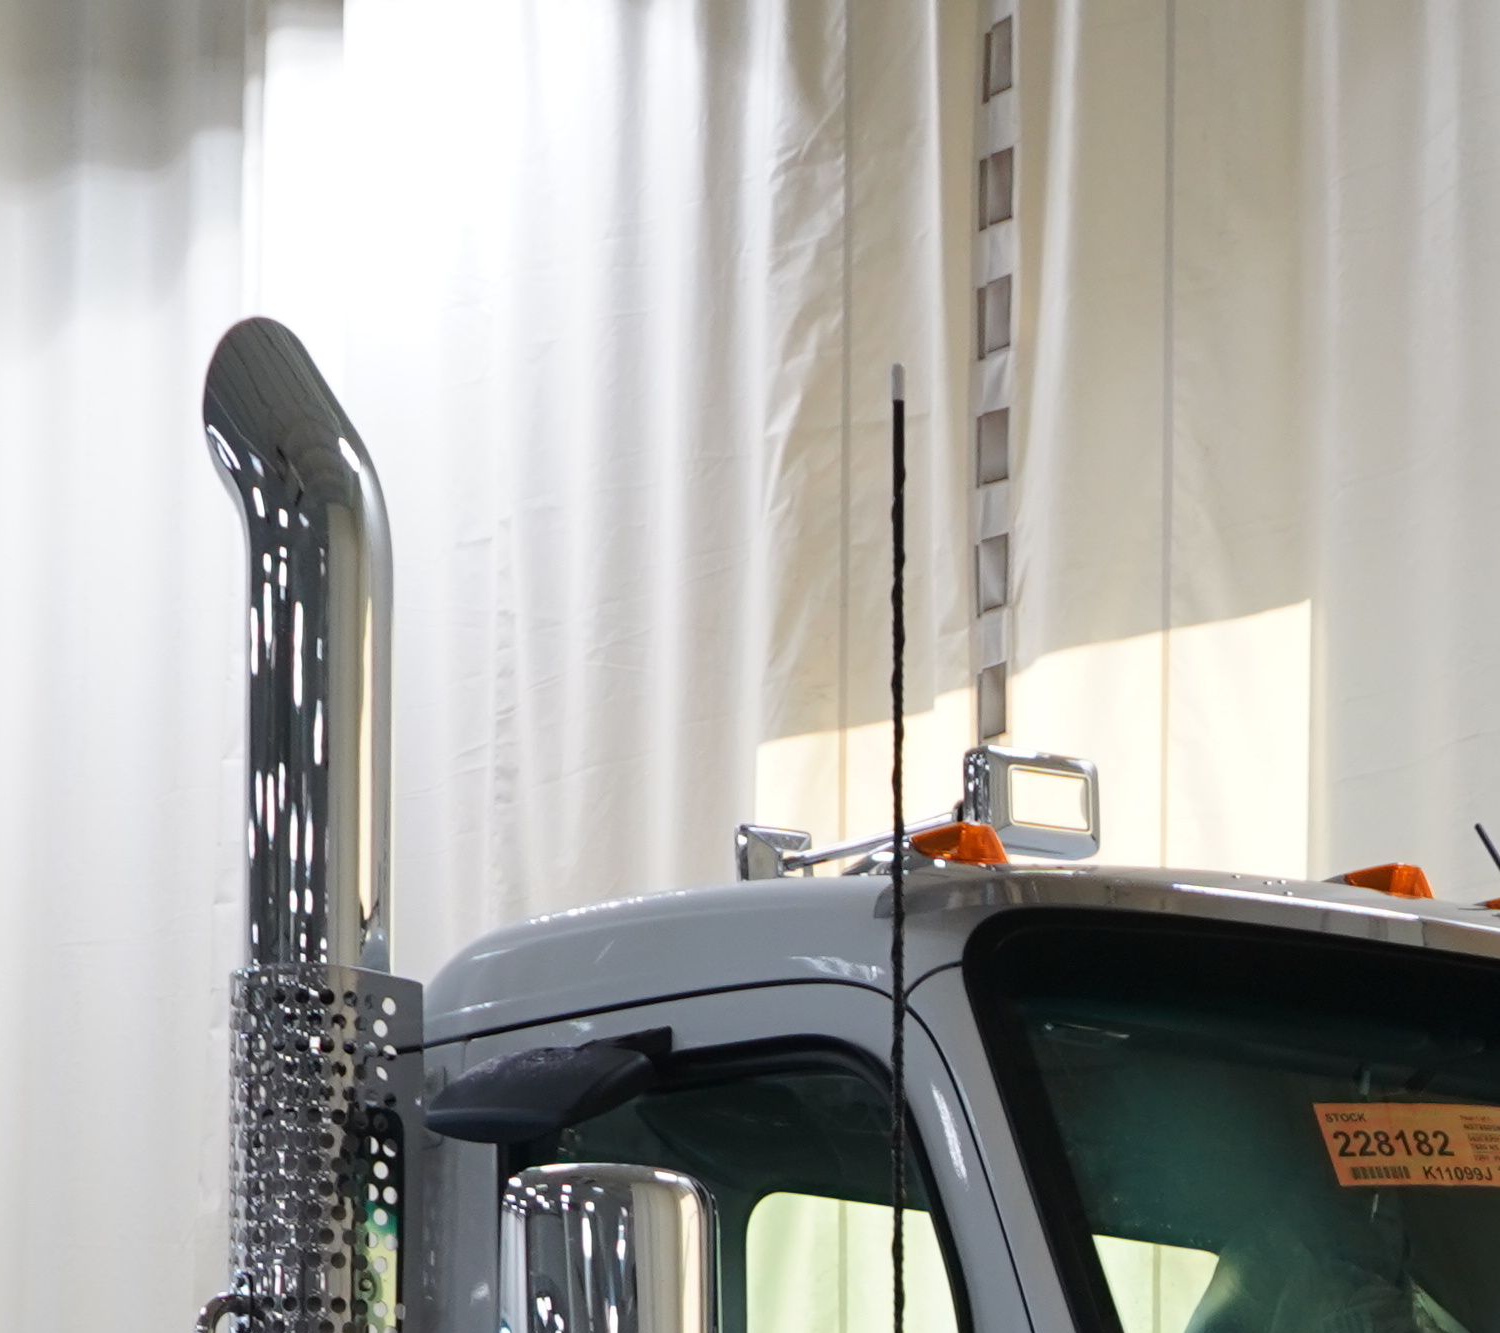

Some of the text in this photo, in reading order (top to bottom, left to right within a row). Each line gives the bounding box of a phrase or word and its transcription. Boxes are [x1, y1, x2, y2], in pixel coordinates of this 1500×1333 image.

[1325, 1113, 1367, 1123] STOCK
[1332, 1129, 1455, 1158] 228182
[1422, 1165, 1494, 1182] K11099J
